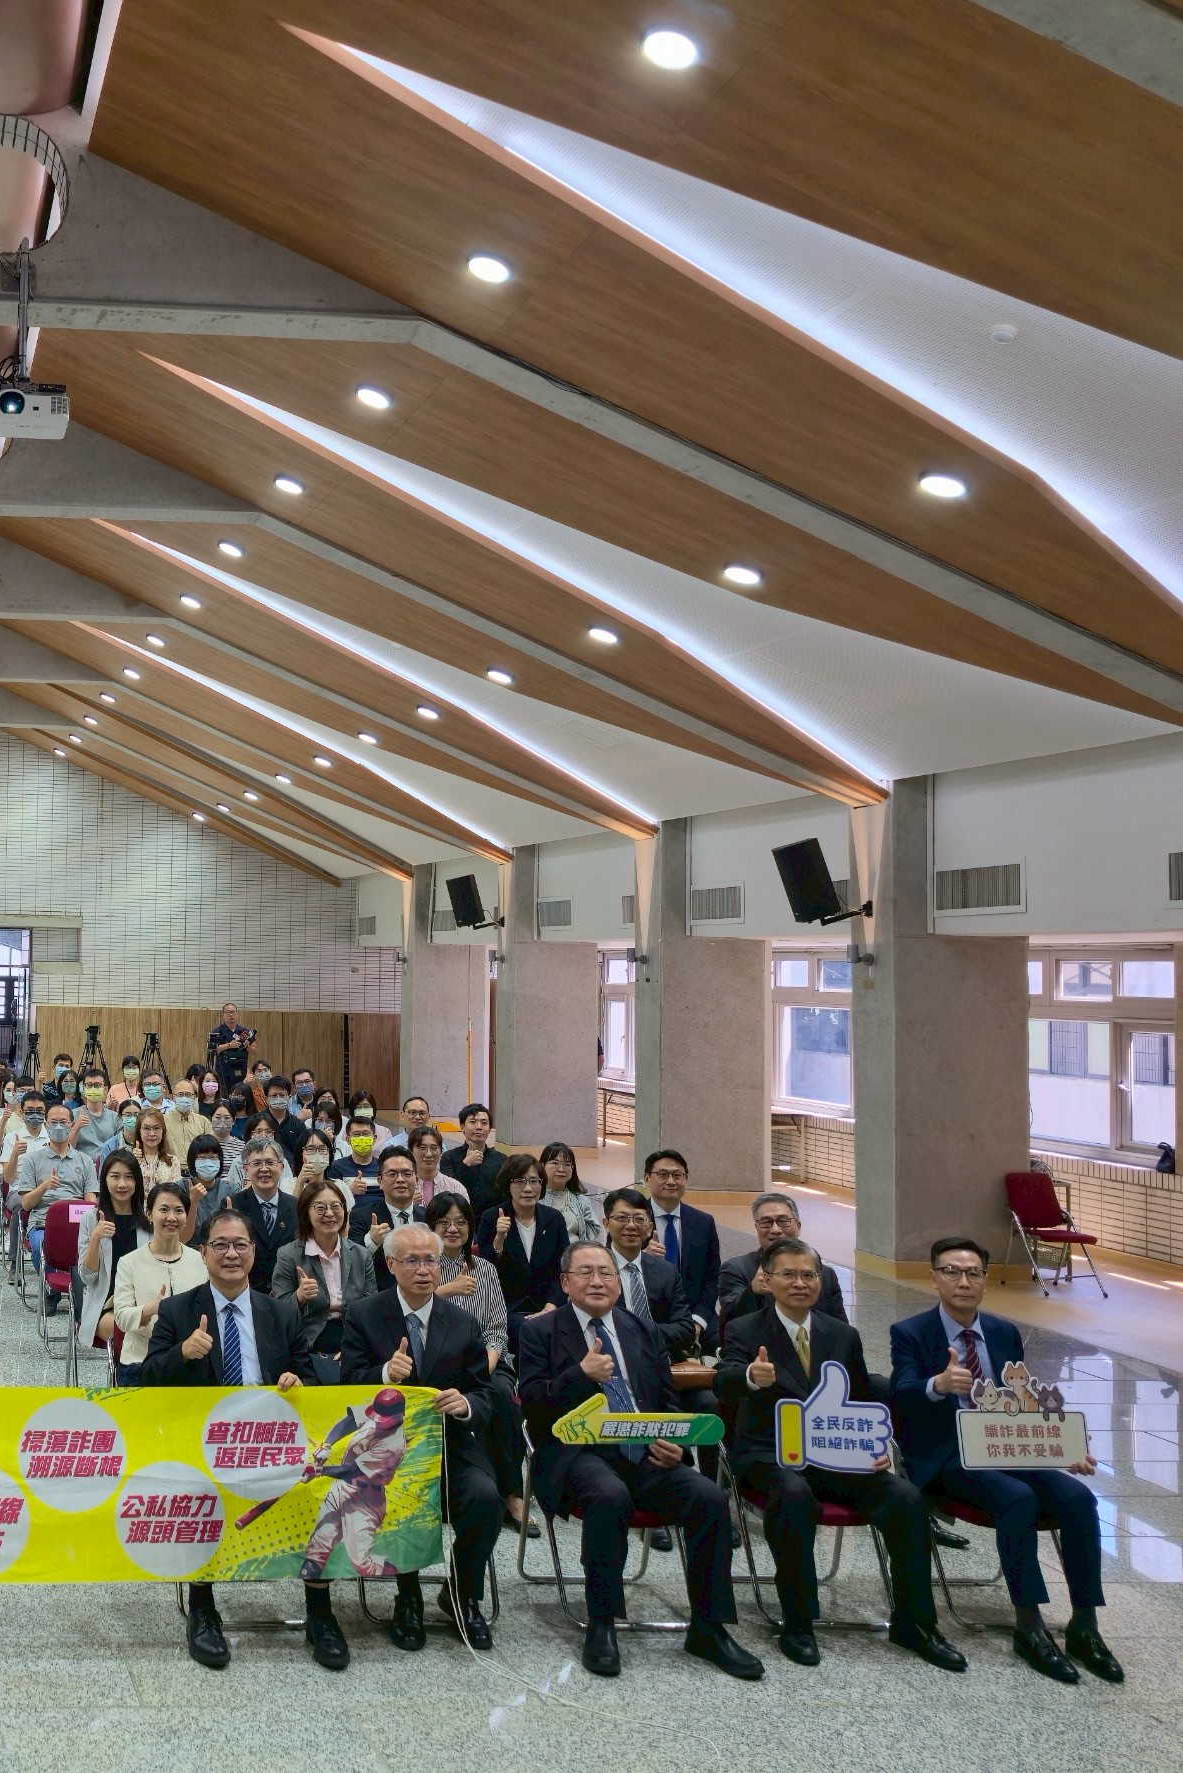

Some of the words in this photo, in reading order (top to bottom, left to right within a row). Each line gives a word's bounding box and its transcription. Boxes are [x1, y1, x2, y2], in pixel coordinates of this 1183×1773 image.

[599, 1421, 691, 1438] 嚴懲詐欺犯罪
[811, 1415, 874, 1433] 全民反詐
[984, 1424, 1062, 1439] 識詐最前線
[20, 1430, 117, 1453] 掃蕩詐團
[811, 1436, 875, 1452] 阻絕詐騙
[986, 1443, 1064, 1458] 你我不受騙
[26, 1455, 123, 1479] 溯源斷根
[213, 1446, 306, 1469] 返還民眾
[119, 1493, 218, 1518] 公私協力
[125, 1519, 224, 1543] 源頭管理
